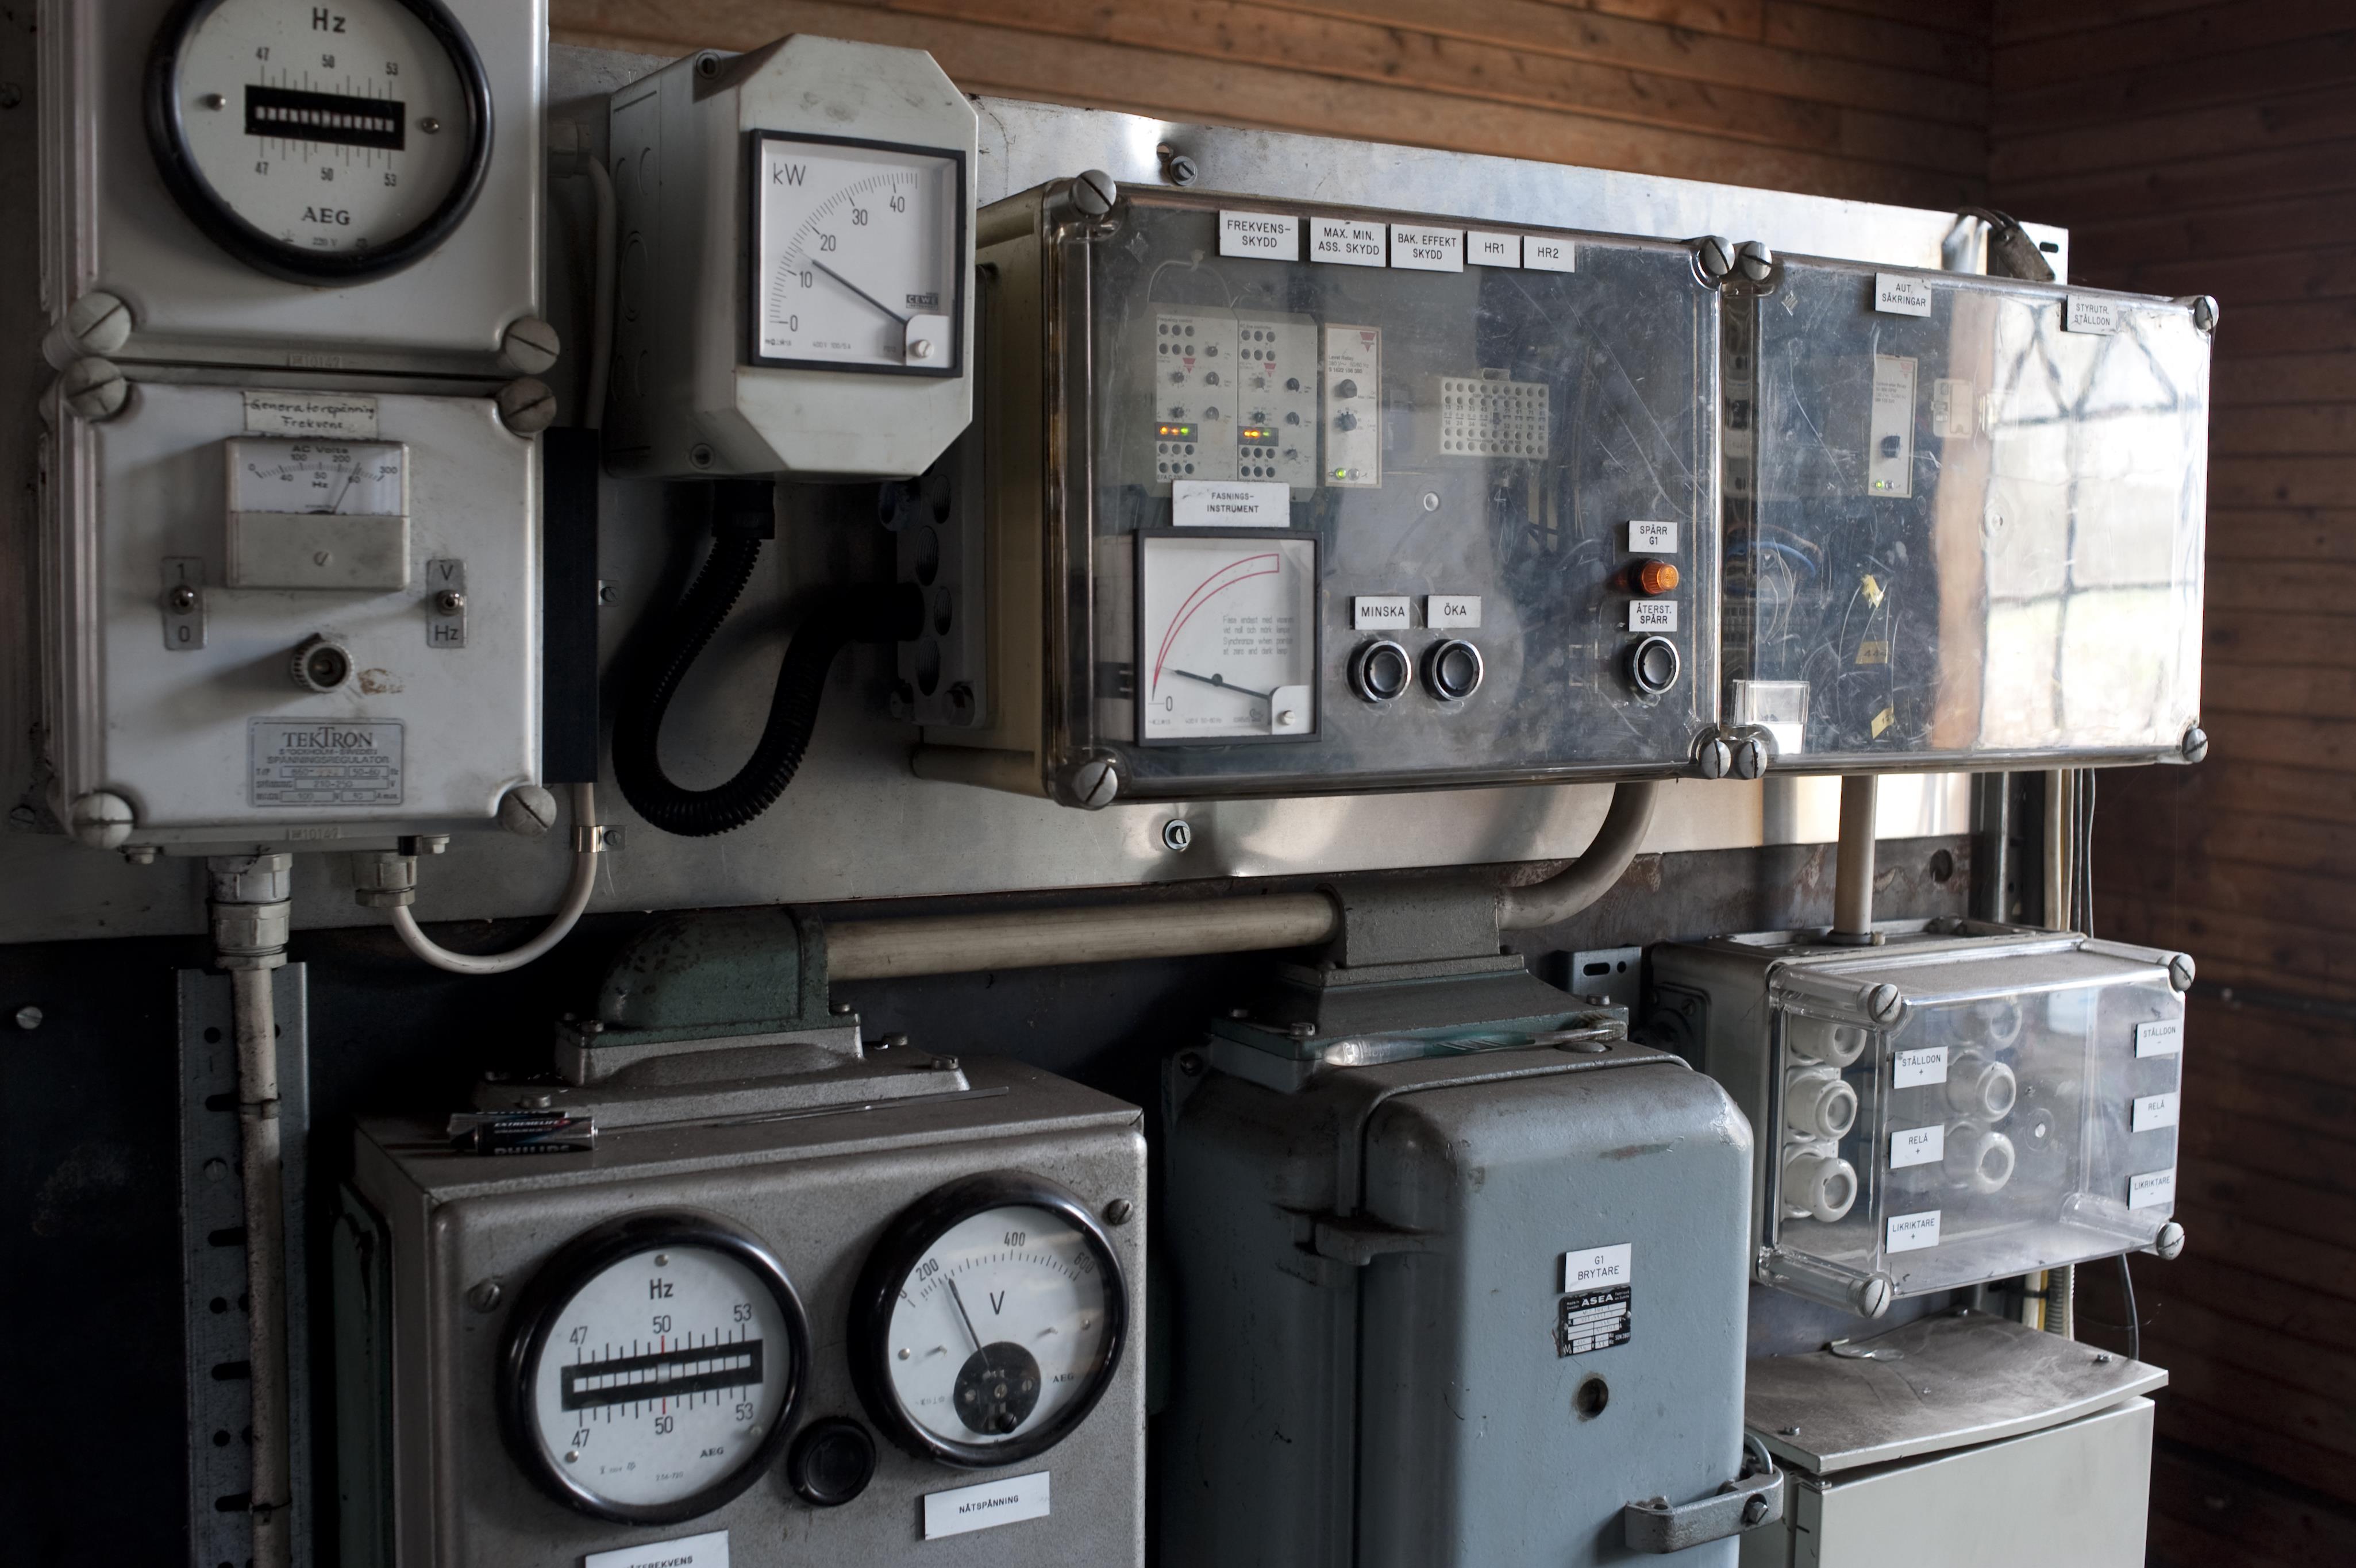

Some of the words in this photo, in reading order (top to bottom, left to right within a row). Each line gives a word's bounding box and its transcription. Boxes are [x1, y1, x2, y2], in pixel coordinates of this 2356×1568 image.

[313, 7, 345, 33] Hz
[256, 47, 270, 61] 47
[322, 54, 335, 68] 50
[386, 61, 399, 76] 53
[255, 161, 269, 175] 47
[321, 167, 334, 181] 50
[773, 163, 806, 186] kW
[384, 173, 397, 187] 53
[890, 195, 905, 213] 40
[301, 206, 350, 225] AEG
[852, 209, 868, 226] 30
[1227, 219, 1291, 234] FREKVENS-
[1323, 227, 1348, 239] MAX.
[1353, 230, 1375, 241] MIN.
[821, 234, 836, 252] 20
[1242, 235, 1277, 248] SKYDD
[1398, 233, 1418, 244] BAK.
[1422, 235, 1457, 248] EFFEKT
[1318, 241, 1341, 252] ASS.
[1346, 243, 1379, 256] SKYDD
[1413, 248, 1442, 260] SKYDD
[1485, 242, 1504, 255] HR1
[1538, 246, 1559, 259] HR2
[800, 271, 813, 288] 10
[1896, 283, 1913, 294] AUT.
[790, 314, 798, 332] 0
[333, 454, 351, 463] 200
[314, 472, 327, 480] 50
[379, 466, 398, 475] 300
[1211, 492, 1254, 500] FASNINGS-
[1207, 504, 1259, 513] INSTRUMENT
[1640, 524, 1667, 535] SPÄRR
[1649, 536, 1658, 545] G1
[440, 565, 453, 580] V
[1361, 606, 1405, 617] MINSKA
[1444, 603, 1466, 616] ÖKA
[1637, 602, 1672, 614] ÅTERST.
[435, 625, 459, 641] Hz
[1166, 696, 1173, 712] 0
[282, 727, 373, 749] TEKTRON
[2134, 1176, 2170, 1190] LIKRIKTARE
[1892, 1218, 1935, 1232] LIKRIKTARE
[1004, 1231, 1025, 1247] 400
[1074, 1251, 1095, 1274] 600
[1595, 1255, 1604, 1265] G1
[916, 1258, 939, 1282] 200
[1578, 1265, 1619, 1281] BRYTARE
[650, 1278, 673, 1300] Hz
[990, 1290, 1004, 1315] V
[1581, 1293, 1614, 1307] ASEA
[734, 1304, 752, 1322] 53
[652, 1315, 671, 1333] 50
[569, 1326, 588, 1345] 47
[1052, 1373, 1074, 1384] AEG
[736, 1403, 753, 1421] 53
[655, 1416, 673, 1435] 50
[572, 1429, 590, 1448] 47
[700, 1447, 724, 1458] AEG
